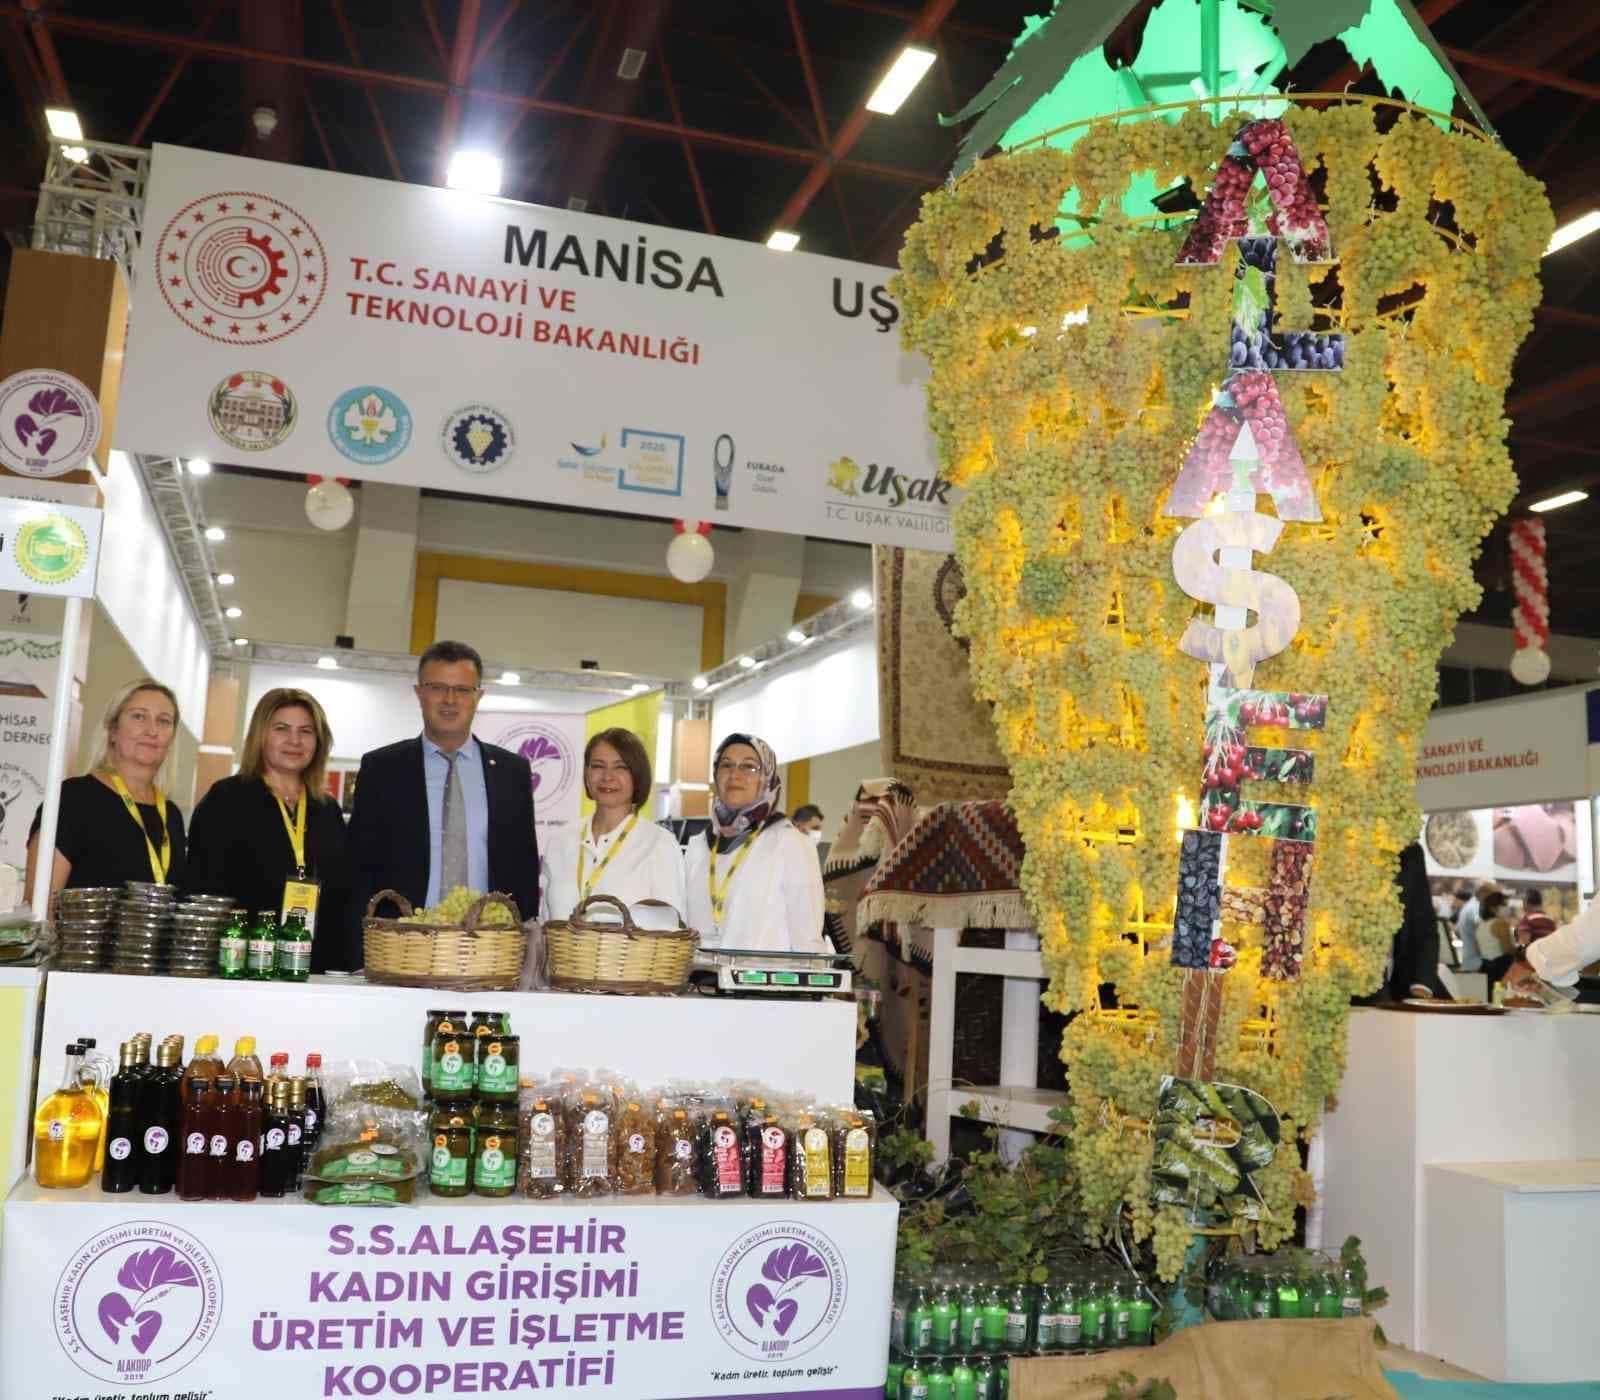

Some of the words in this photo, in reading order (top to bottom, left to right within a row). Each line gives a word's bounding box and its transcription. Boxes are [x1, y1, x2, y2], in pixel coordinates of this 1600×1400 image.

[504, 225, 724, 297] MANİSA
[350, 258, 402, 286] T.C.
[413, 267, 528, 305] SANAYİ
[538, 286, 576, 312] VE
[833, 277, 899, 333] UŞ
[346, 292, 522, 339] TEKNOLOJİ
[533, 324, 699, 365] BAKANLIĞI
[862, 464, 952, 508] Uşak
[855, 511, 891, 527] UŞAK
[0, 712, 37, 727] HİSAR
[3, 731, 51, 745] DERNE
[1416, 761, 1465, 778] KNOLOJİ
[1468, 749, 1538, 773] BAKANLIĞI
[1424, 741, 1465, 759] SANAYİ
[1468, 739, 1483, 752] VE
[328, 1218, 626, 1261] S.S.ALAŞEHİR
[68, 1252, 91, 1283] KADIN
[309, 1270, 451, 1303] KADIN
[466, 1261, 639, 1304] GİRİŞİMİ
[251, 1310, 423, 1351] ÜRETİM
[437, 1316, 495, 1347] VE
[508, 1310, 685, 1350] İŞLETME
[117, 1359, 152, 1373] ALAKOOP
[323, 1350, 615, 1397] KOOPERATİFİ
